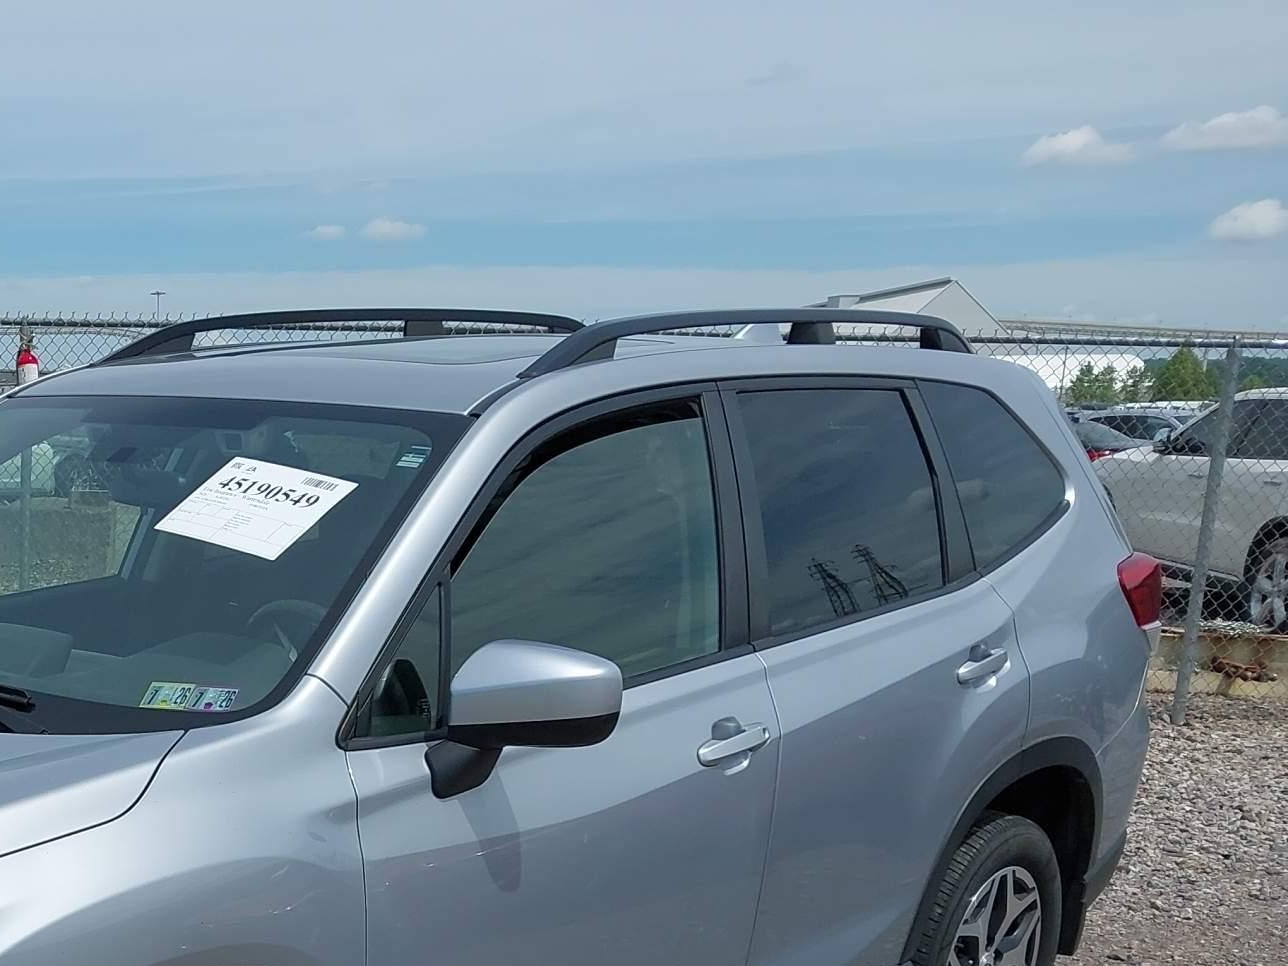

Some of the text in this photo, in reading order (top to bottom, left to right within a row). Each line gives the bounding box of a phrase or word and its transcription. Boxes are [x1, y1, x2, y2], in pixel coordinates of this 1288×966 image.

[218, 475, 320, 509] 45190549
[173, 687, 192, 705] 26
[218, 690, 237, 709] 26
